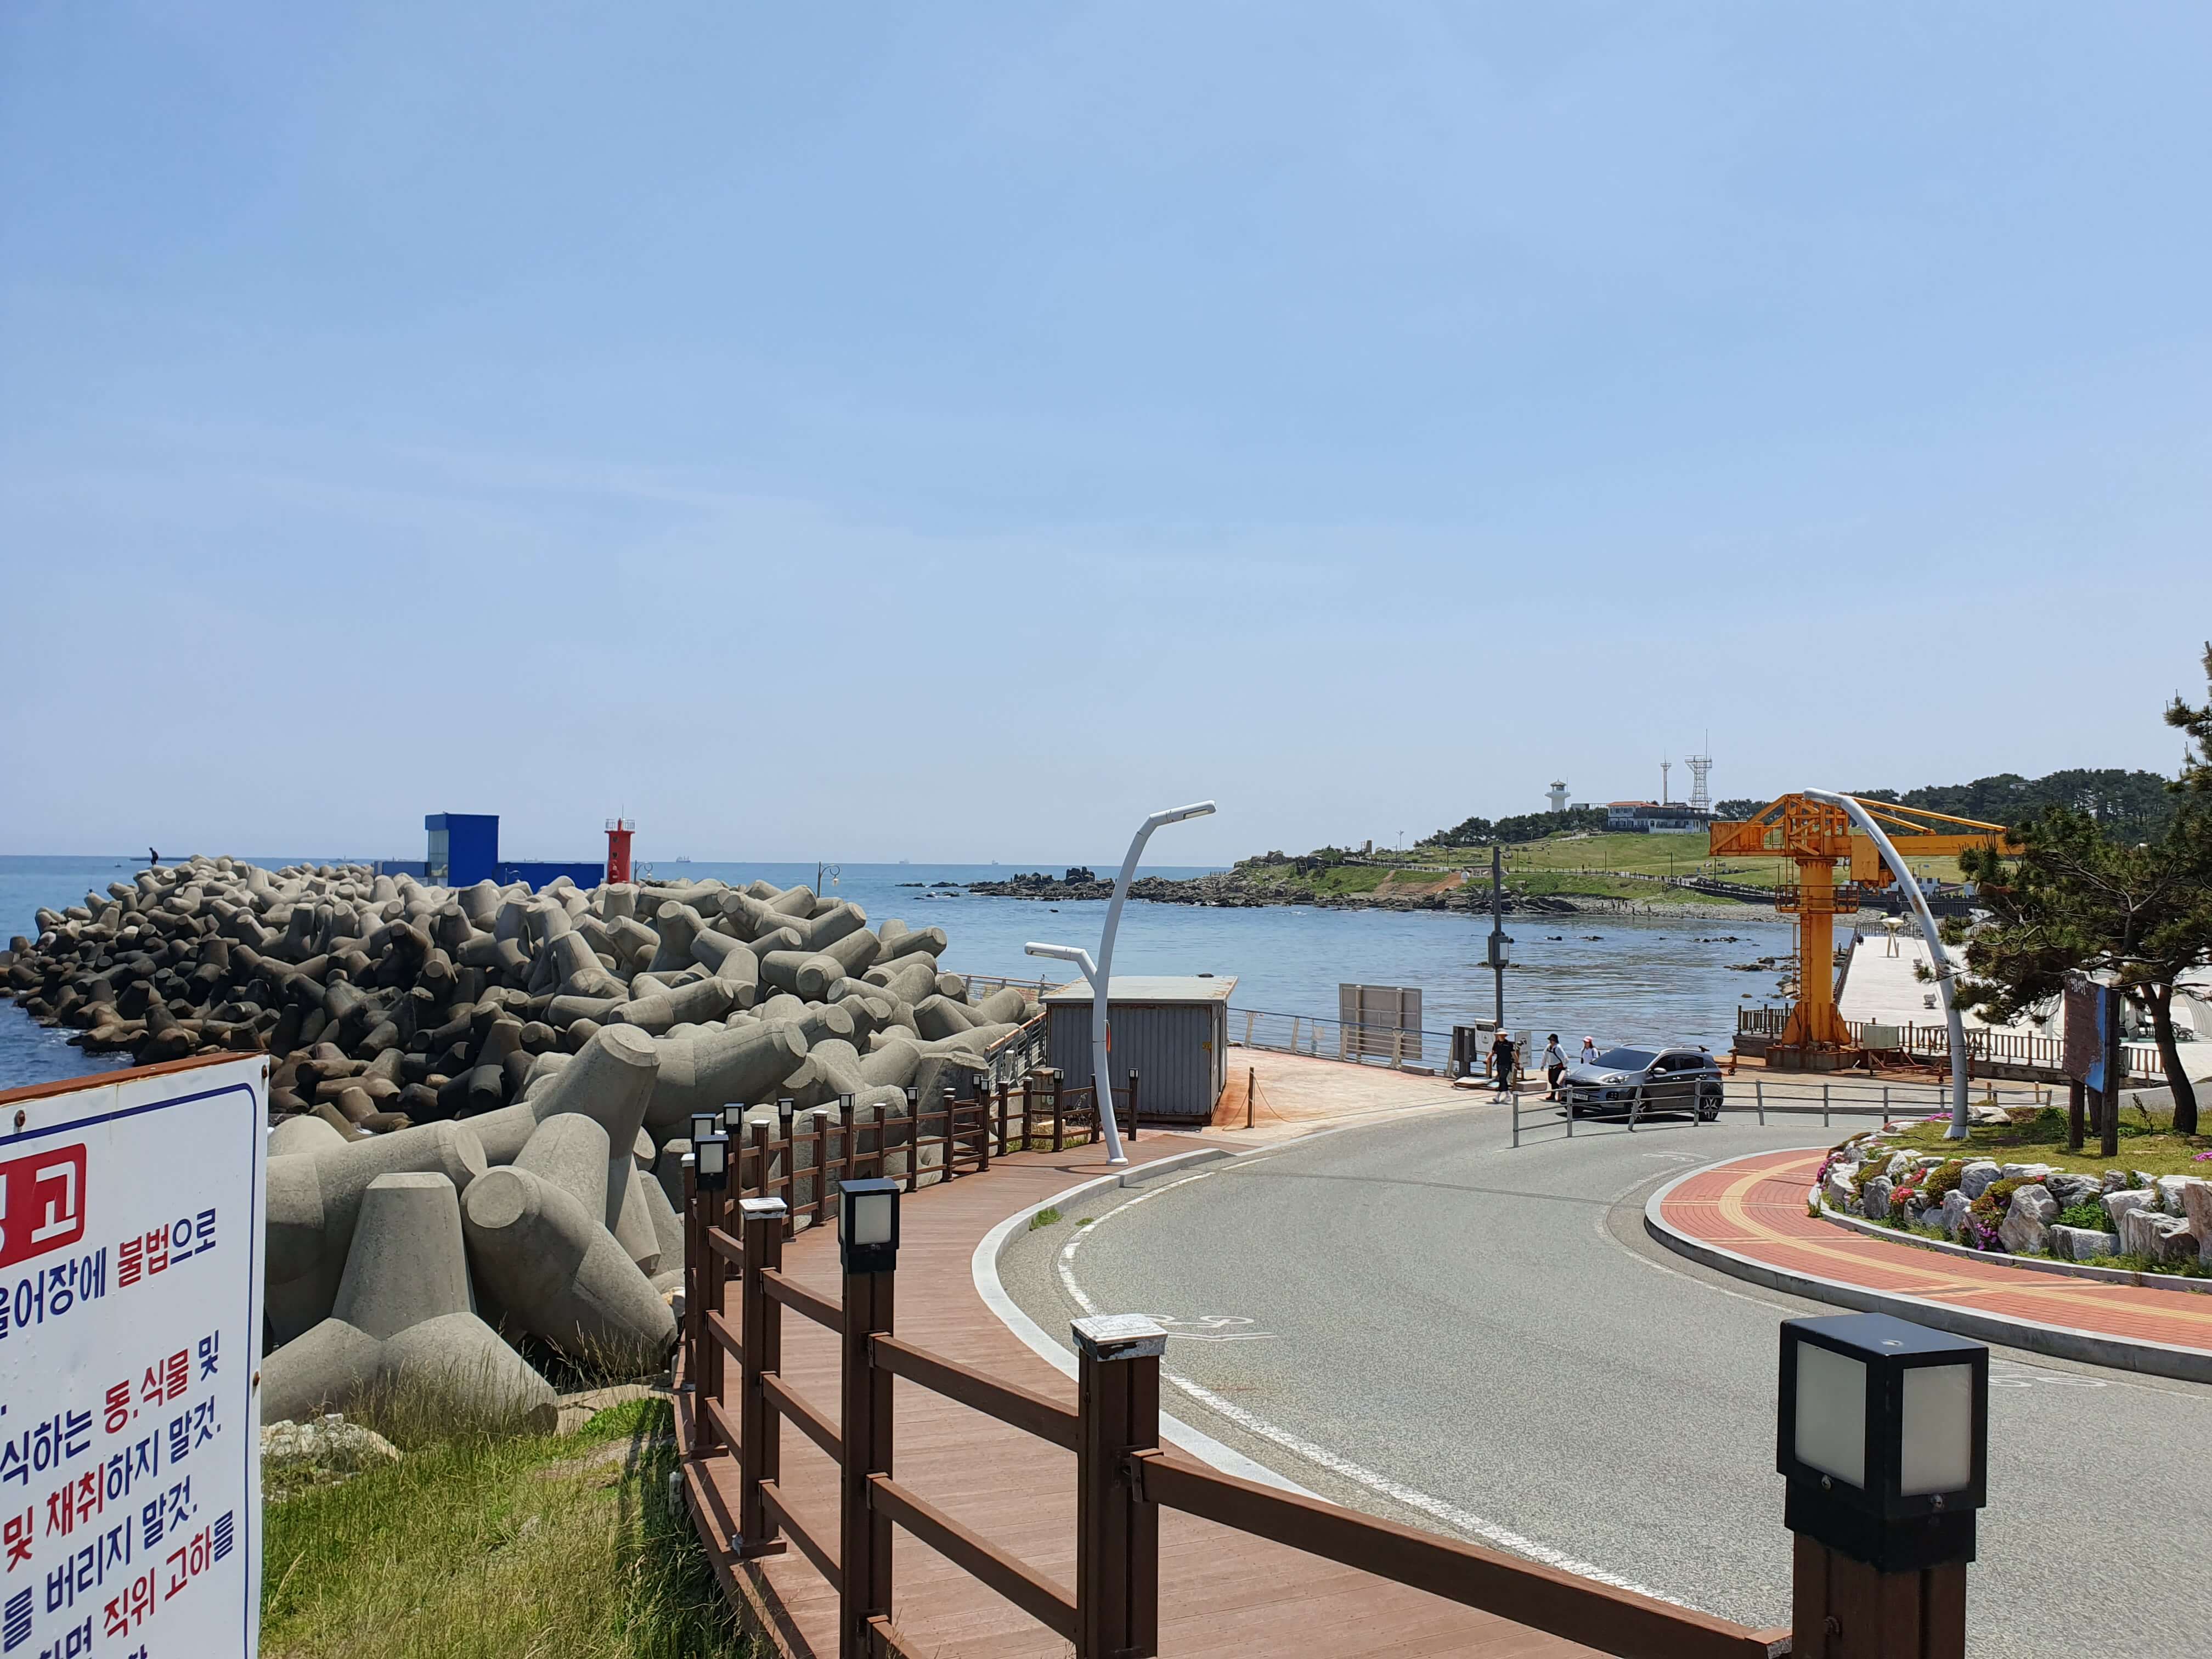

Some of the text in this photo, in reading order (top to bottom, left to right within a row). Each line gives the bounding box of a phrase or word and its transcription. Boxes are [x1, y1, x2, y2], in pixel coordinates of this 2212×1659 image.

[117, 1208, 216, 1288] 불법으로
[104, 1348, 189, 1434] 동.식물
[199, 1329, 219, 1381] 및
[4, 1395, 221, 1573] 및 채취하지 말것.
[3, 1474, 197, 1653] 를 버리지 말것.
[104, 1566, 155, 1638] 직위
[165, 1509, 234, 1601] 고하를
